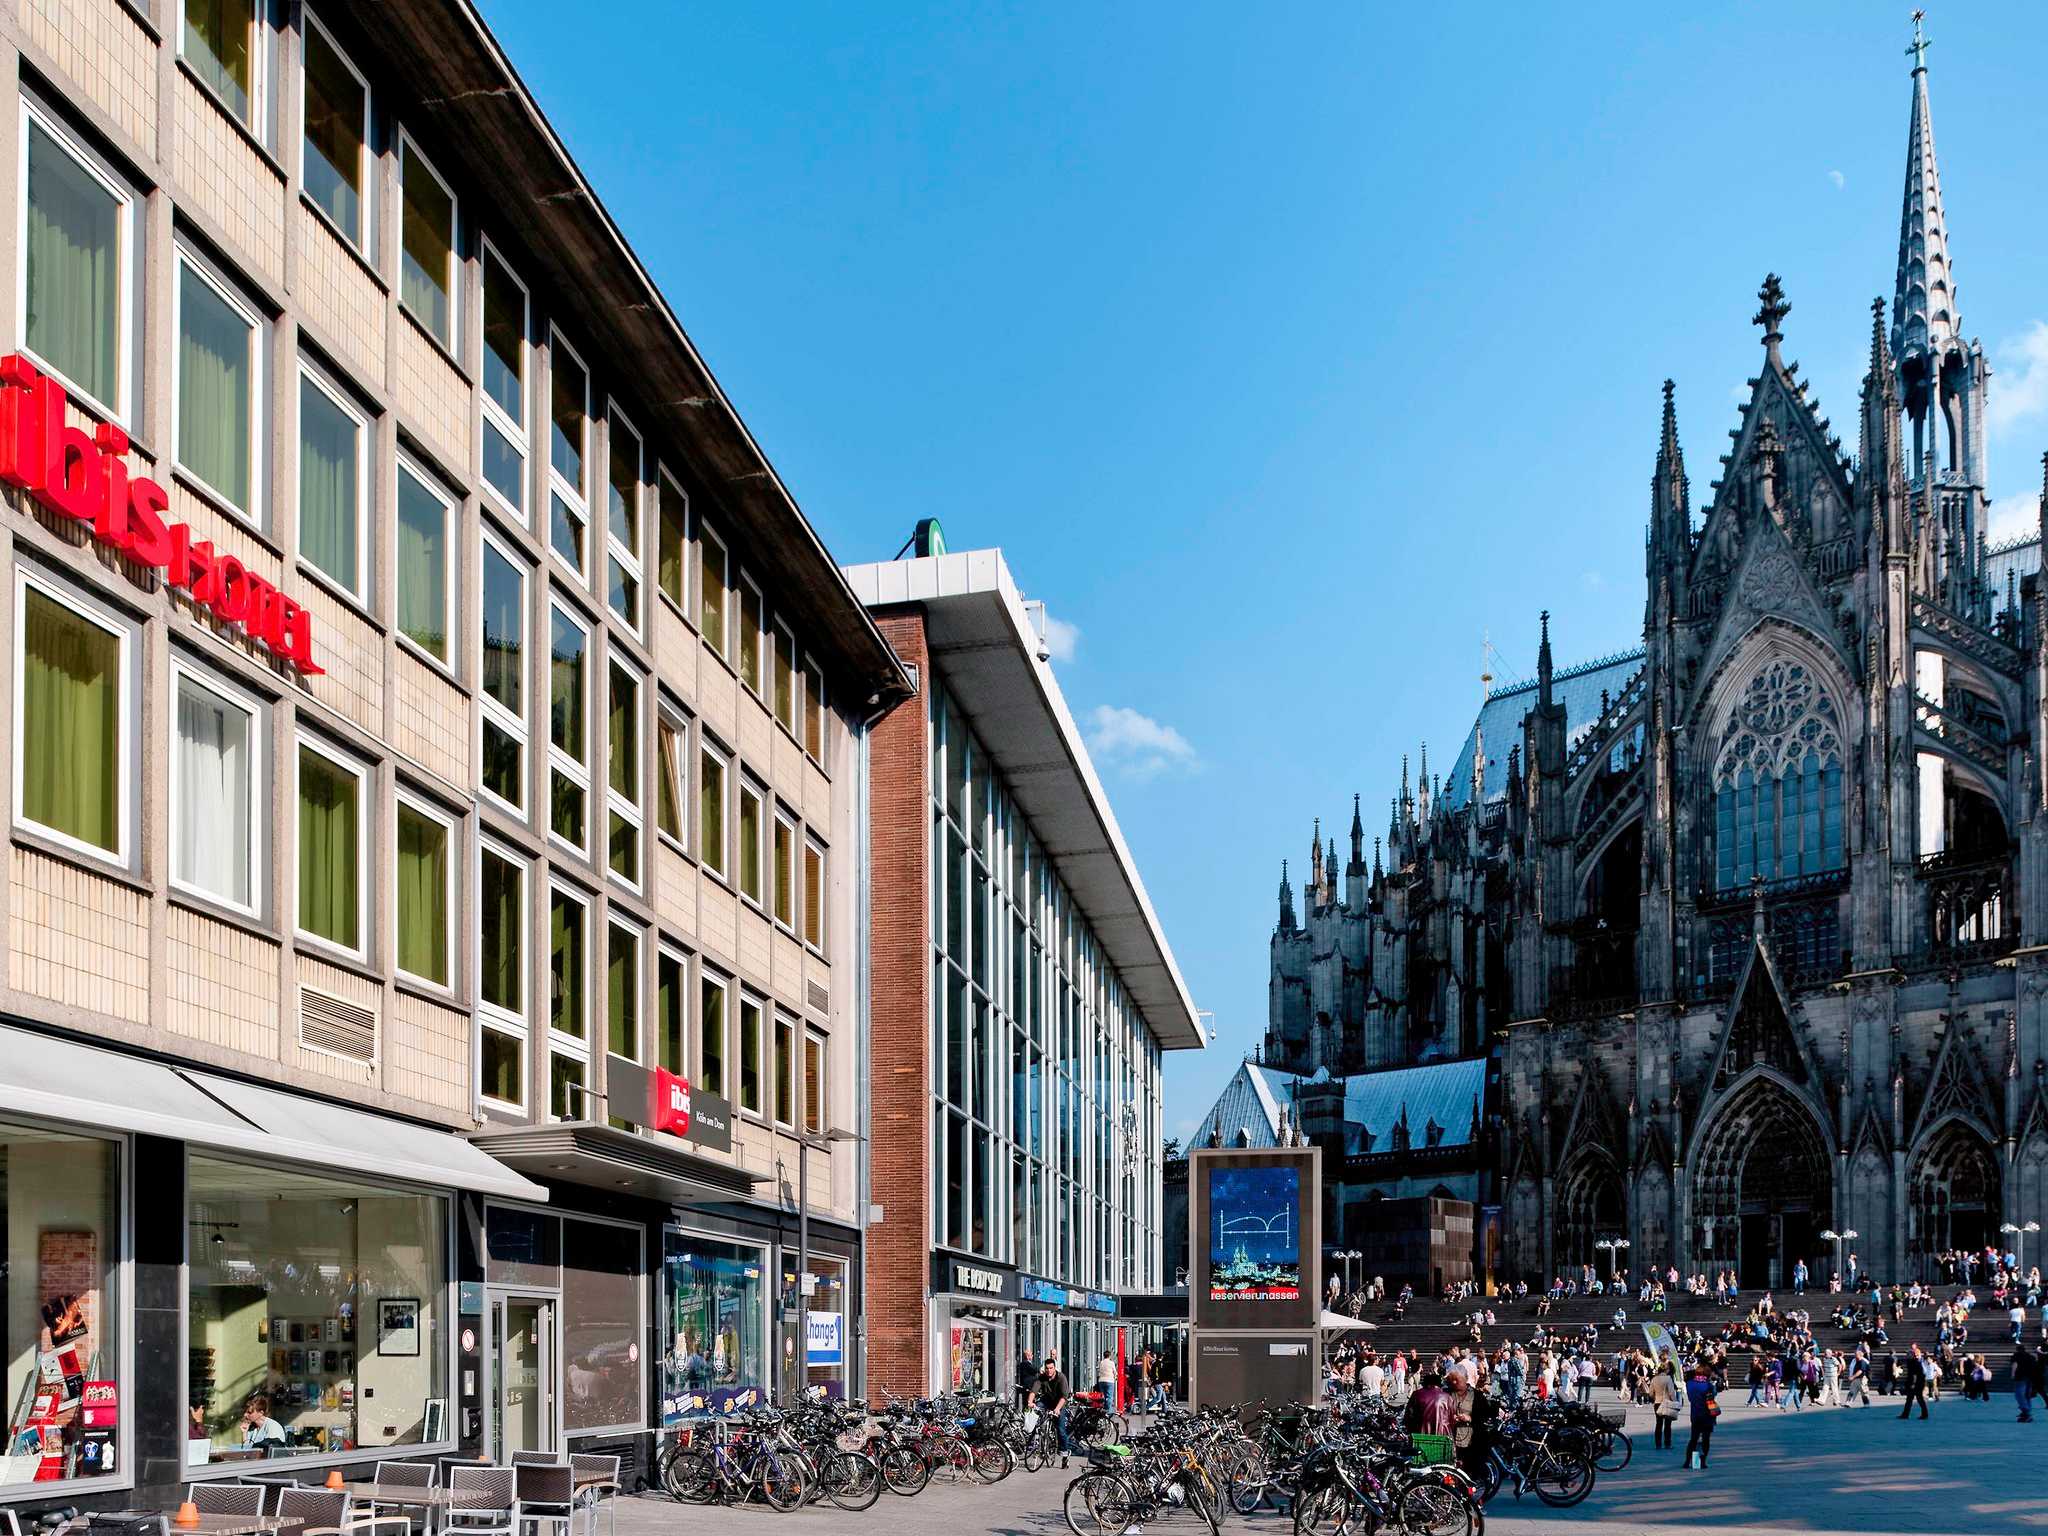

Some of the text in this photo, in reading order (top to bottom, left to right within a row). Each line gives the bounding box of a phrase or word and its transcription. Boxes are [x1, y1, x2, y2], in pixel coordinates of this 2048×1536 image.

[0, 354, 325, 675] ibis HOTEL
[671, 1084, 691, 1115] ibis
[696, 1110, 706, 1124] Köln
[707, 1117, 714, 1127] am
[714, 1117, 725, 1131] Dom
[957, 1265, 970, 1288] THE
[971, 1268, 988, 1291] BODY
[988, 1271, 1003, 1293] SHOP
[807, 1315, 835, 1347] hange
